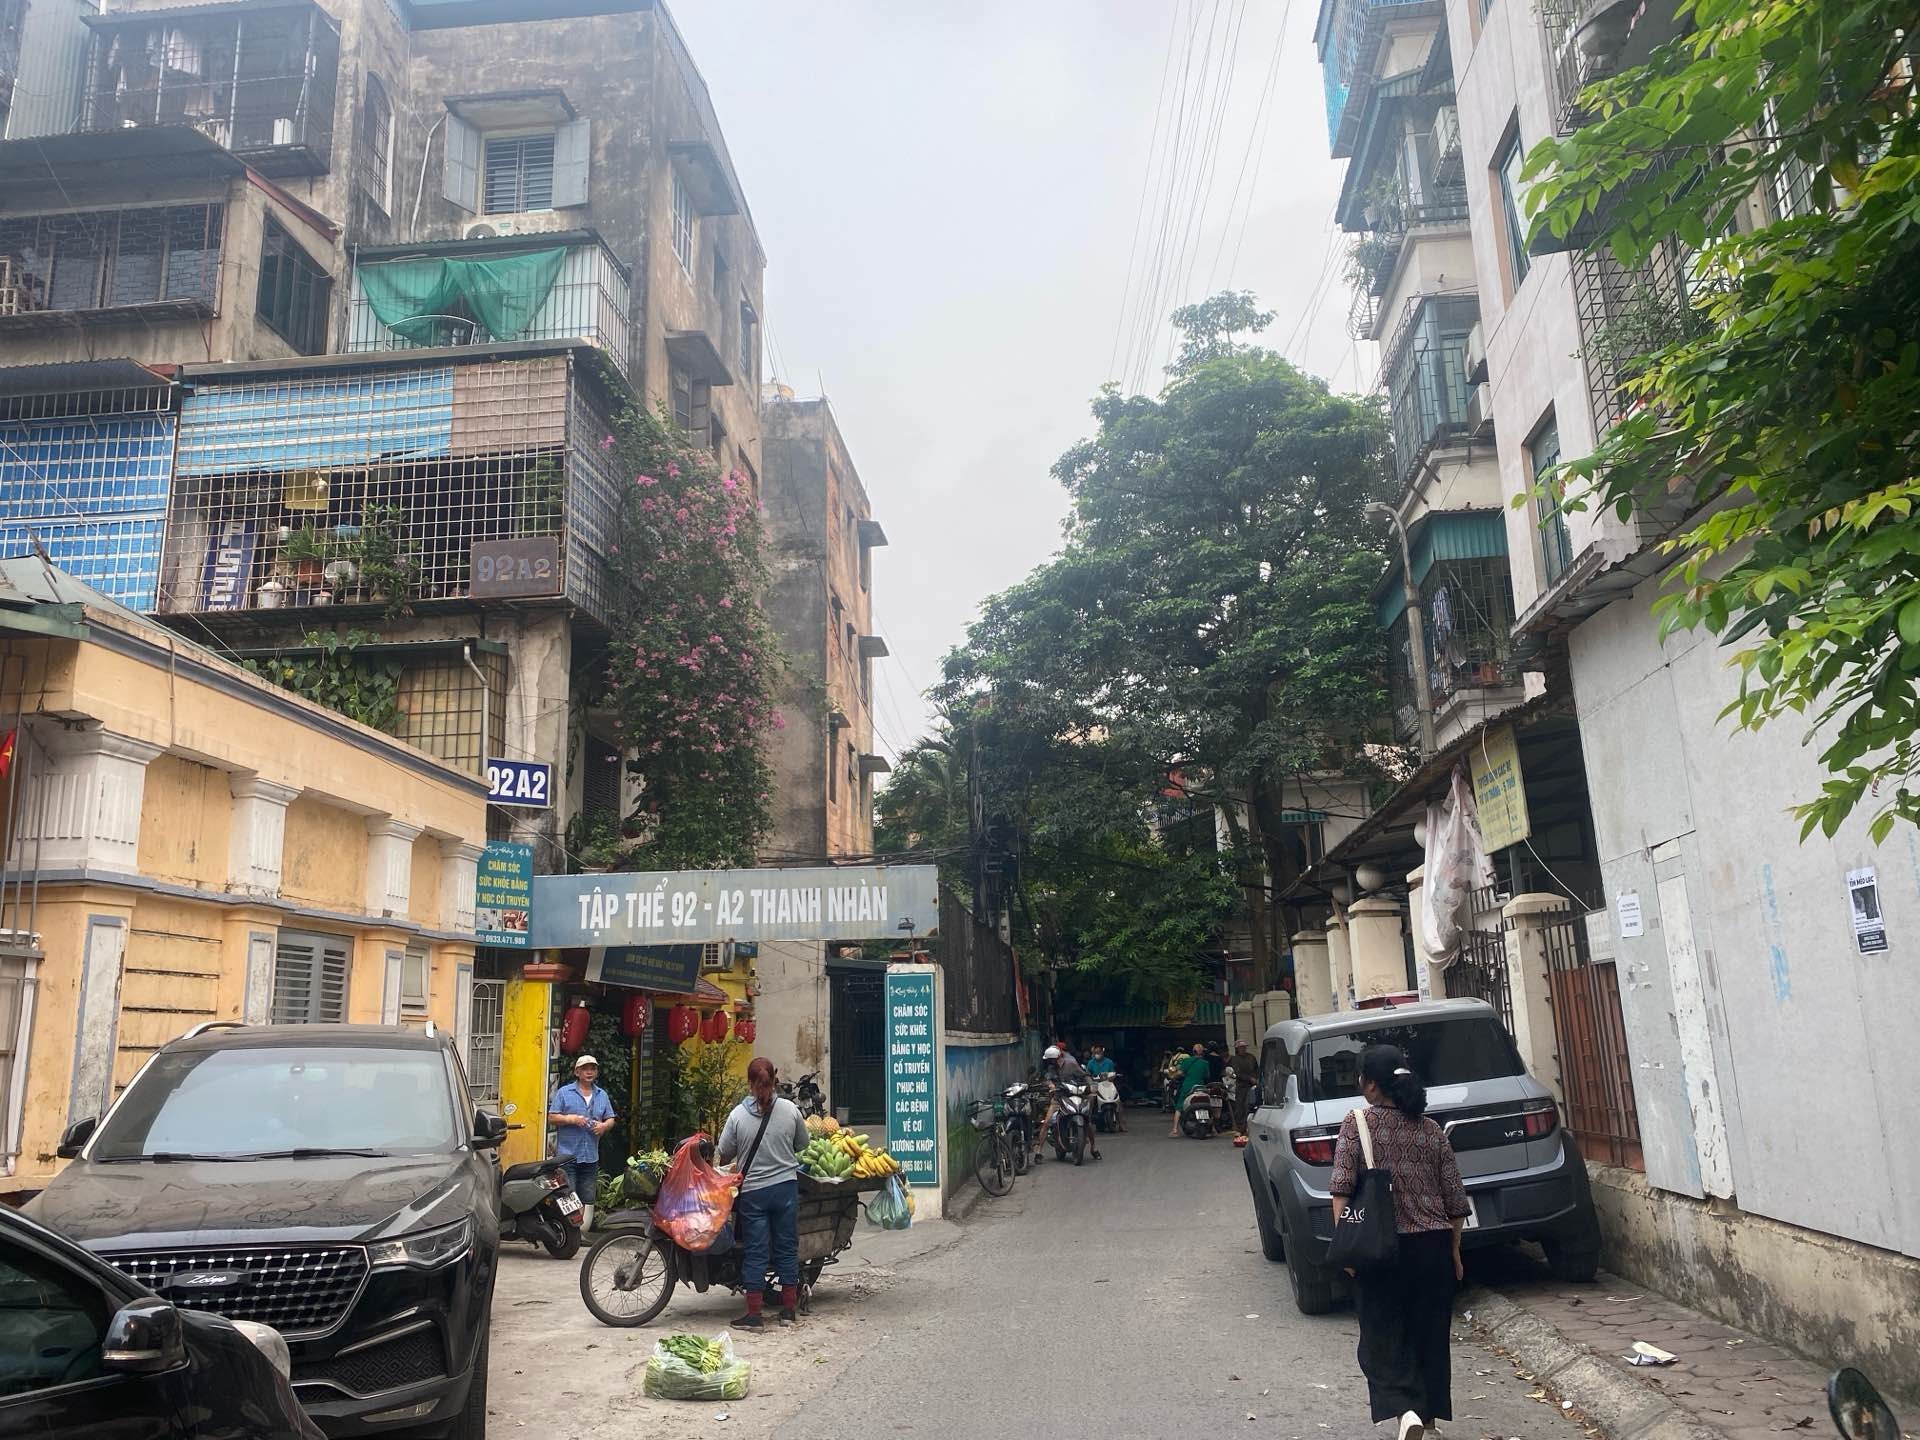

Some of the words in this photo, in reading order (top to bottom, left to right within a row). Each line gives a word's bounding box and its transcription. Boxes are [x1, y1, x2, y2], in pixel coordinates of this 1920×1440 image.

[477, 555, 551, 582] 92A2
[487, 766, 546, 800] 92A2
[488, 859, 507, 872] CHĂM
[507, 861, 521, 875] SÓC
[478, 874, 493, 886] SỨC
[476, 892, 481, 903] Y
[482, 892, 495, 906] HỌC
[578, 886, 619, 937] TẬP
[626, 877, 668, 928] THỂ
[671, 891, 697, 927] 92
[704, 902, 712, 910] -
[716, 889, 744, 926] A2
[750, 887, 822, 925] THANH
[828, 878, 888, 922] NHÀN
[893, 1004, 913, 1018] CHĂM
[914, 1002, 928, 1017] SÓC
[895, 1022, 909, 1036] SỨC
[909, 1021, 928, 1036] KHỎE
[911, 1043, 917, 1055] Y
[917, 1042, 931, 1057] HỌC
[895, 1099, 910, 1113] CÁC
[910, 1098, 929, 1115] BỆNH
[912, 1119, 923, 1132] CƠ
[891, 1138, 915, 1152] XƯƠNG
[915, 1137, 934, 1152] KHỚP
